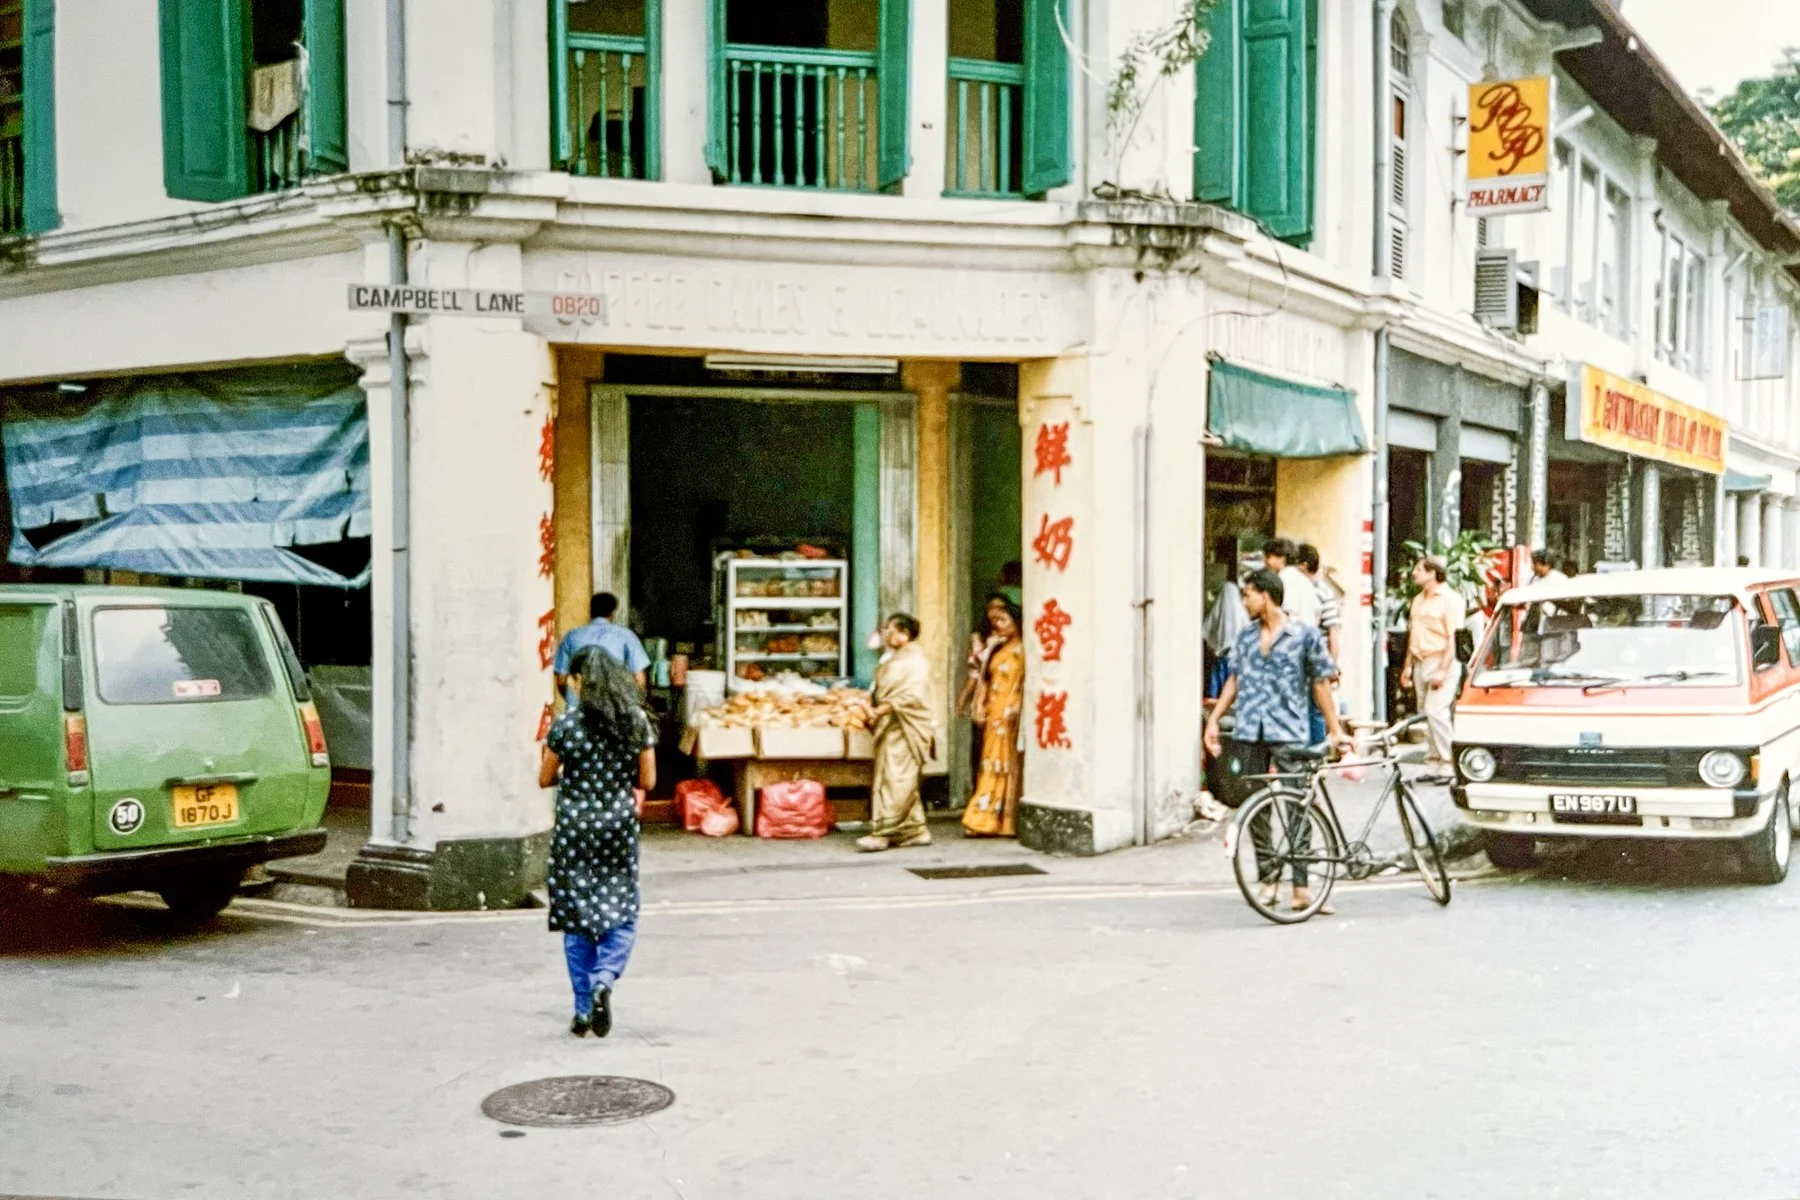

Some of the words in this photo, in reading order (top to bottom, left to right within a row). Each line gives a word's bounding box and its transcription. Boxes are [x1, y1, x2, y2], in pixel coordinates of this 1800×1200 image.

[1467, 185, 1545, 208] PHARMACY
[355, 286, 462, 311] CAMPBELL
[475, 291, 525, 313] LANE
[551, 295, 600, 316] 0820
[195, 785, 216, 802] GF
[116, 804, 138, 824] 50
